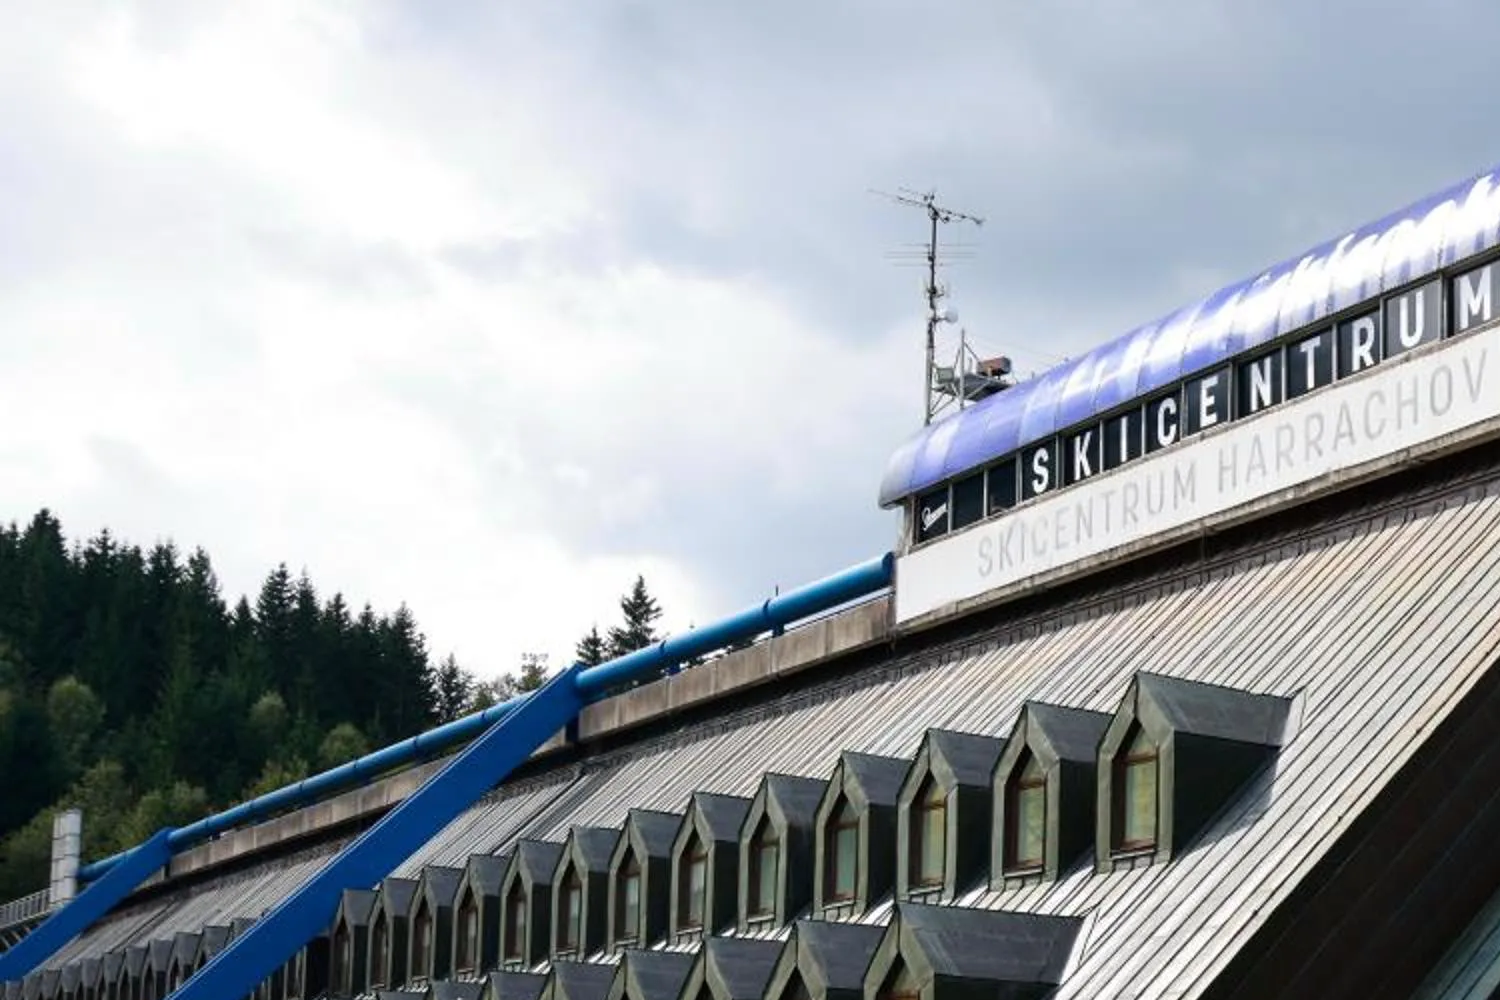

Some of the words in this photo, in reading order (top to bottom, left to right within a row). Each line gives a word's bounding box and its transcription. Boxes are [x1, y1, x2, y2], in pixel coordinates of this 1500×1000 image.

[978, 461, 1196, 577] SKICENTRUM
[1218, 348, 1487, 494] HARRACHOV
[1032, 266, 1491, 493] SKICENTRUM
